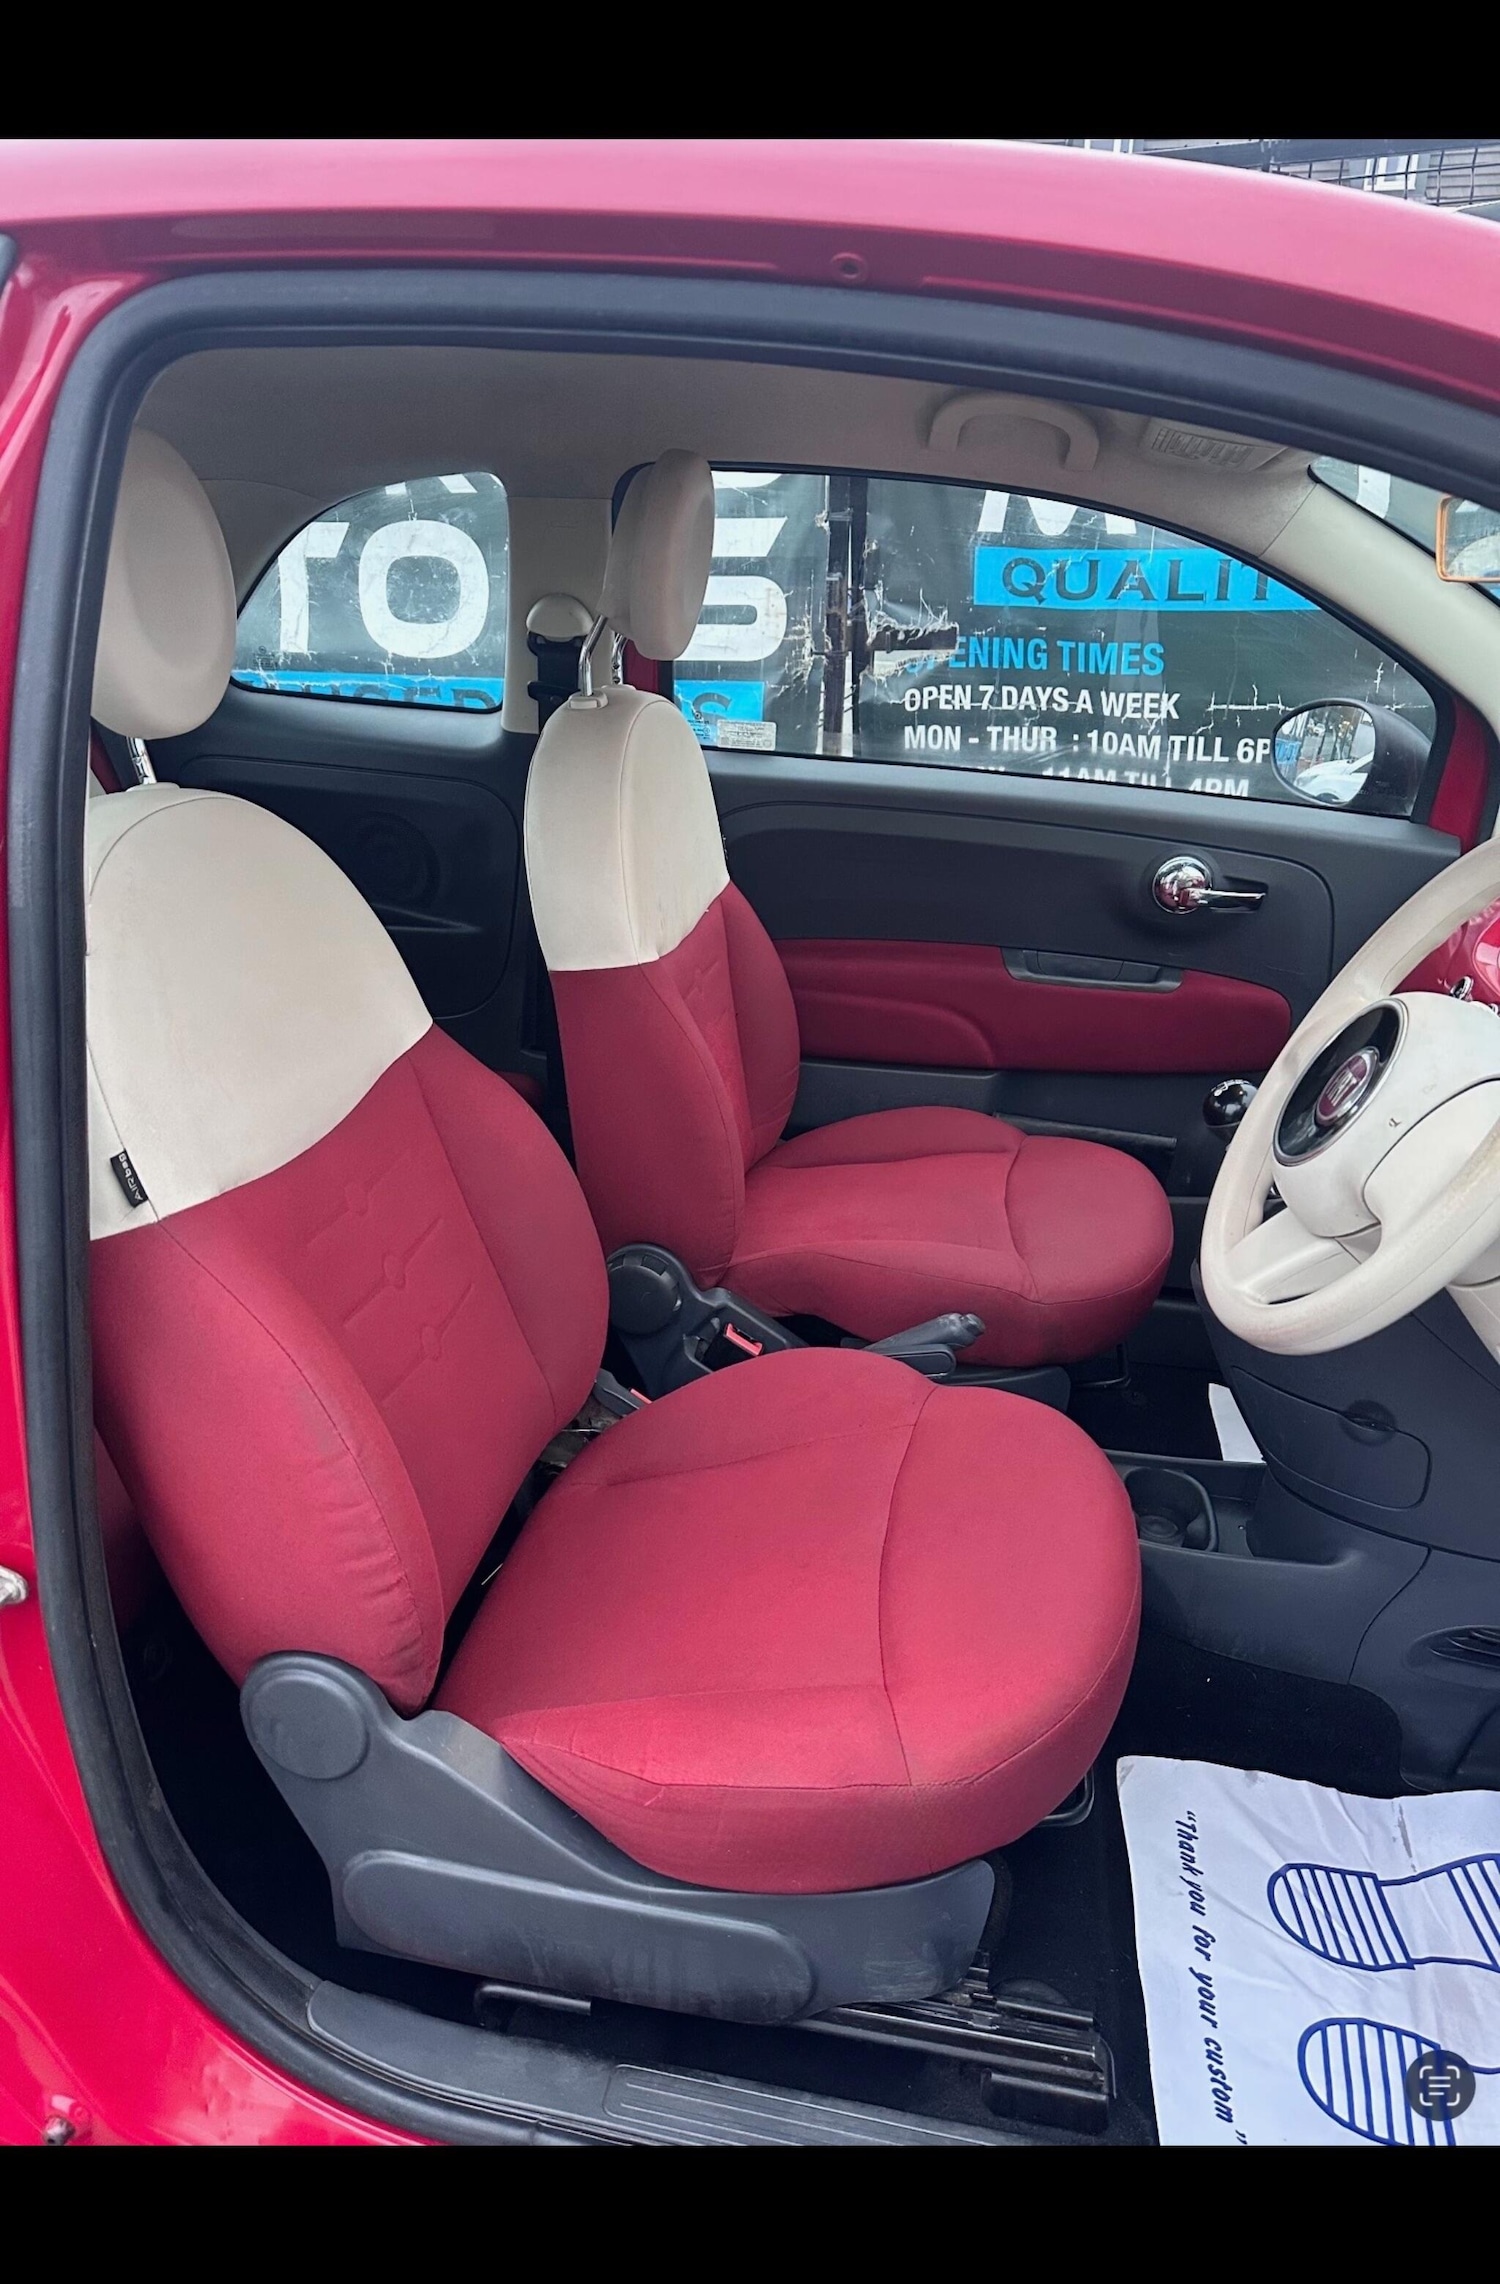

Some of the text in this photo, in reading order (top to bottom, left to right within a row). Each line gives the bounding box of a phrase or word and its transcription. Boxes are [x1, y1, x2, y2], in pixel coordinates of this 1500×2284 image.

[1002, 556, 1270, 605] QUALIT
[906, 636, 1165, 677] ENING TIMES
[904, 684, 1181, 720] OPEN 7 DAYS A WEEK
[904, 724, 962, 751] MON
[986, 725, 1058, 751] THUR
[1087, 730, 1162, 761] 10AM
[1169, 735, 1230, 763] TILL
[1236, 738, 1272, 764] 6P
[1179, 1875, 1207, 1917] you
[1192, 1924, 1216, 1962] for
[1188, 1966, 1218, 2029] your
